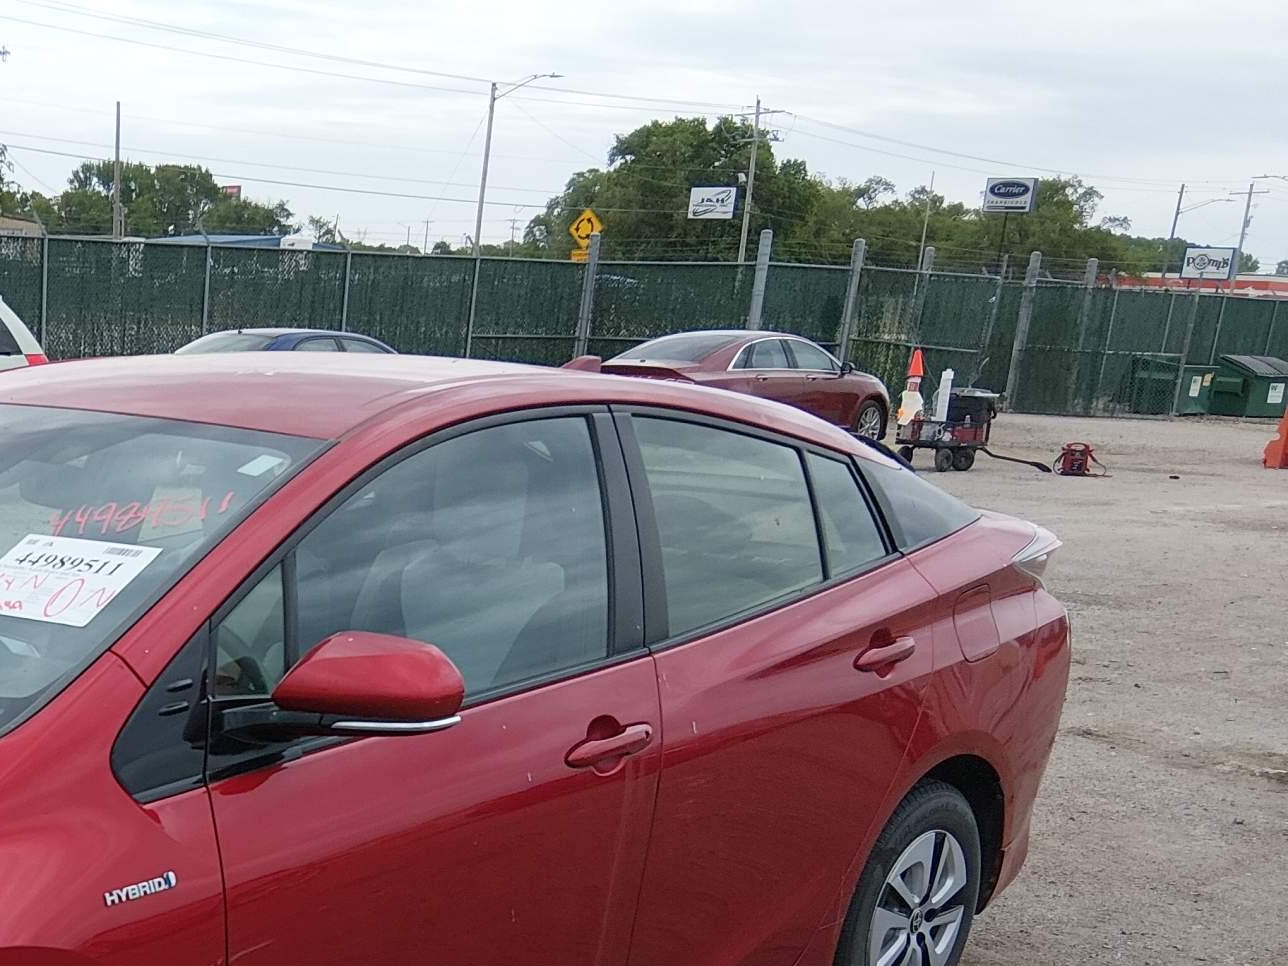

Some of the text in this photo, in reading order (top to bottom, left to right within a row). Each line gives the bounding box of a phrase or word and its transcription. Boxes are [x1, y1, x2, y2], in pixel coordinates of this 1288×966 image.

[998, 184, 1025, 193] Carrier
[15, 550, 124, 577] 44989511
[104, 876, 166, 906] HYBRID
